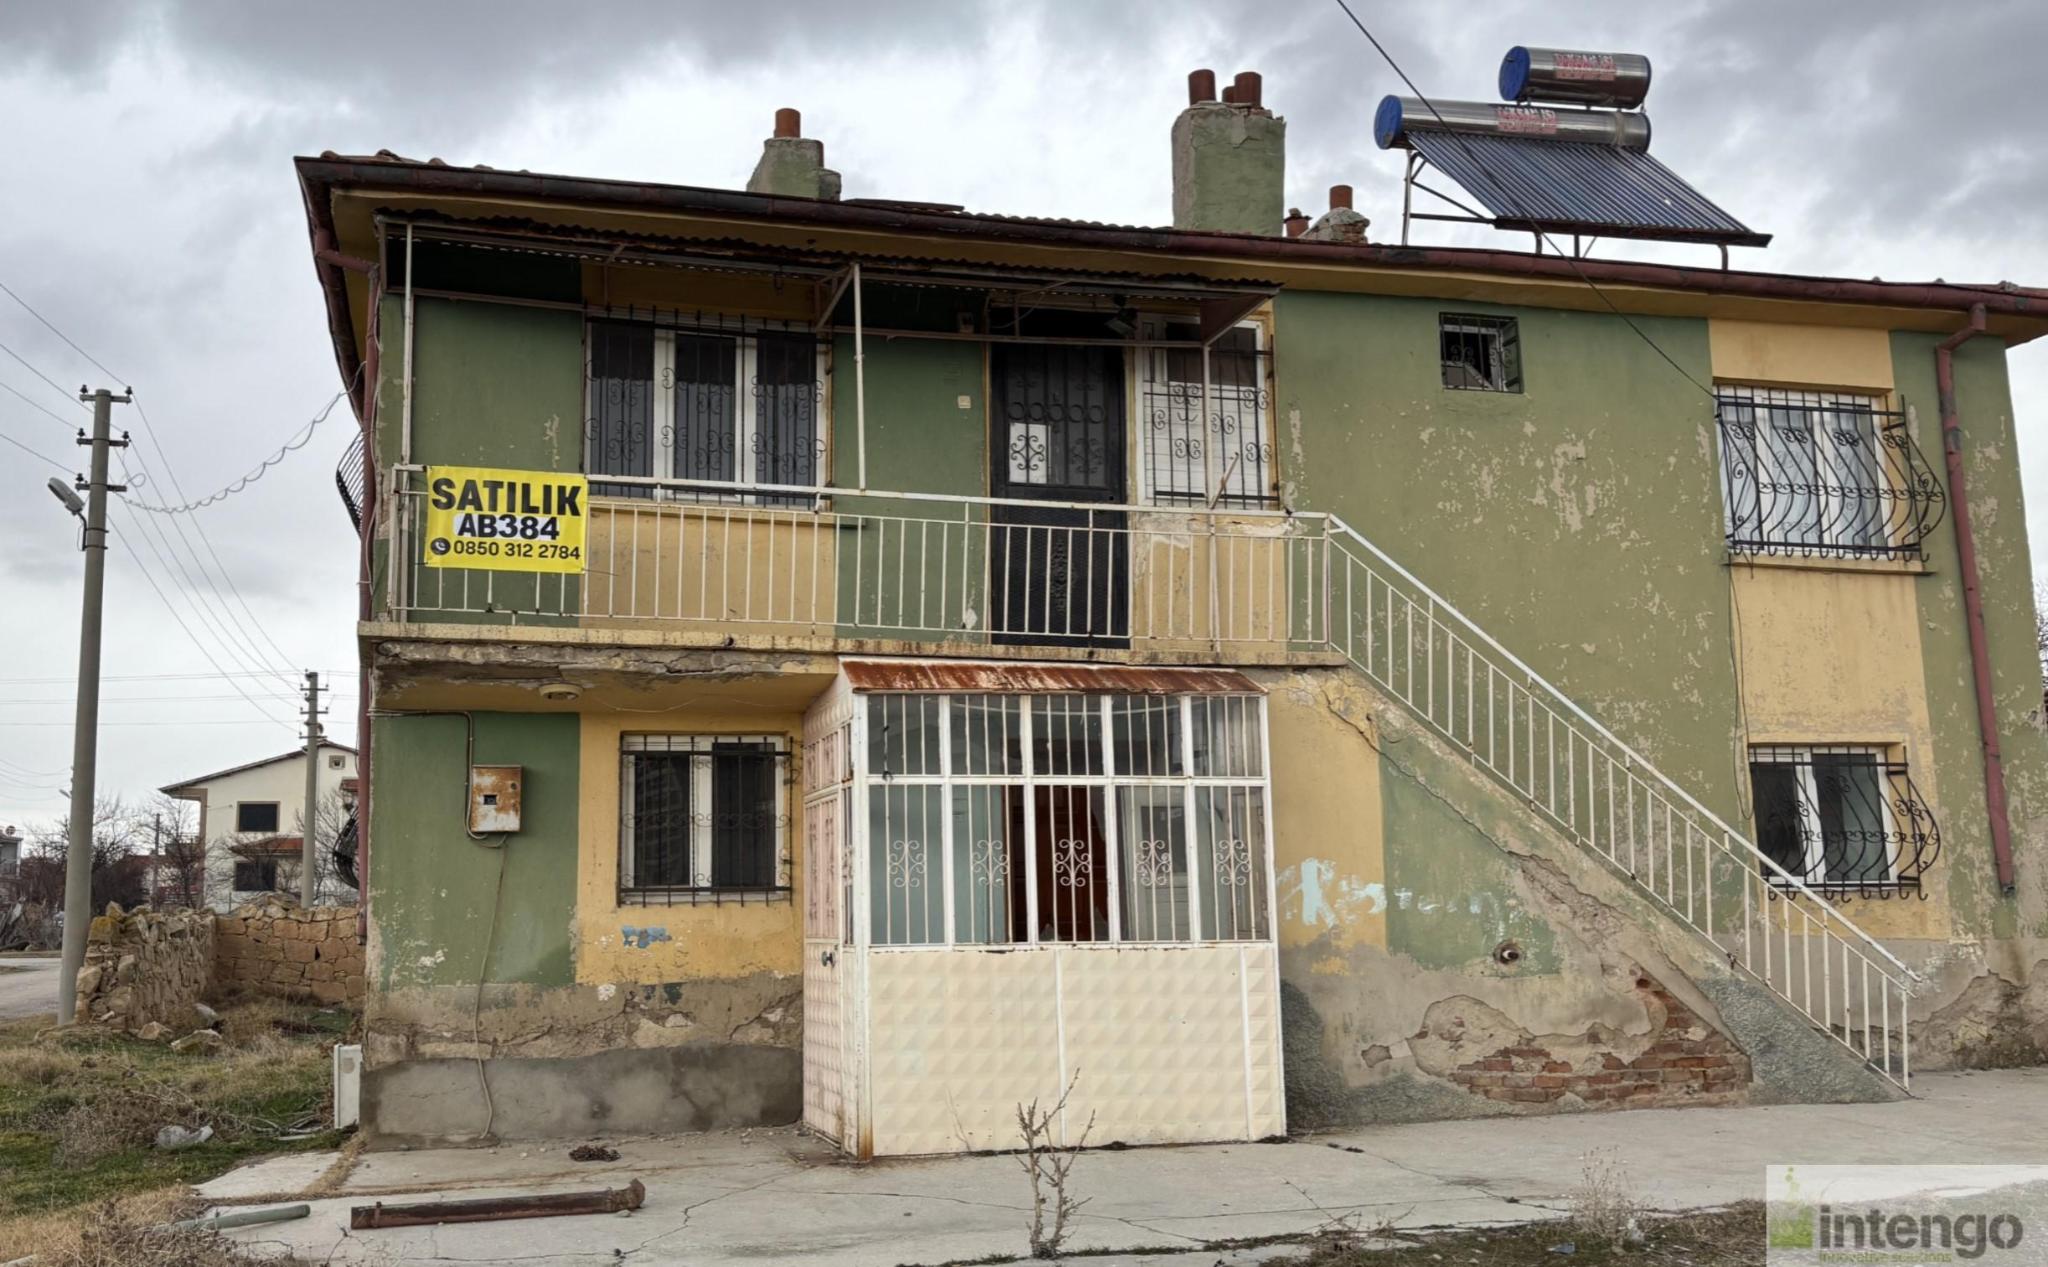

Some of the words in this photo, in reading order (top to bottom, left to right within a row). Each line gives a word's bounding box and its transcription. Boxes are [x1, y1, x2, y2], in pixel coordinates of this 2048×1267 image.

[432, 478, 581, 516] SATILIK
[457, 513, 560, 540] AB384
[453, 540, 499, 556] 0850
[505, 542, 533, 558] 312
[538, 545, 580, 560] 2784
